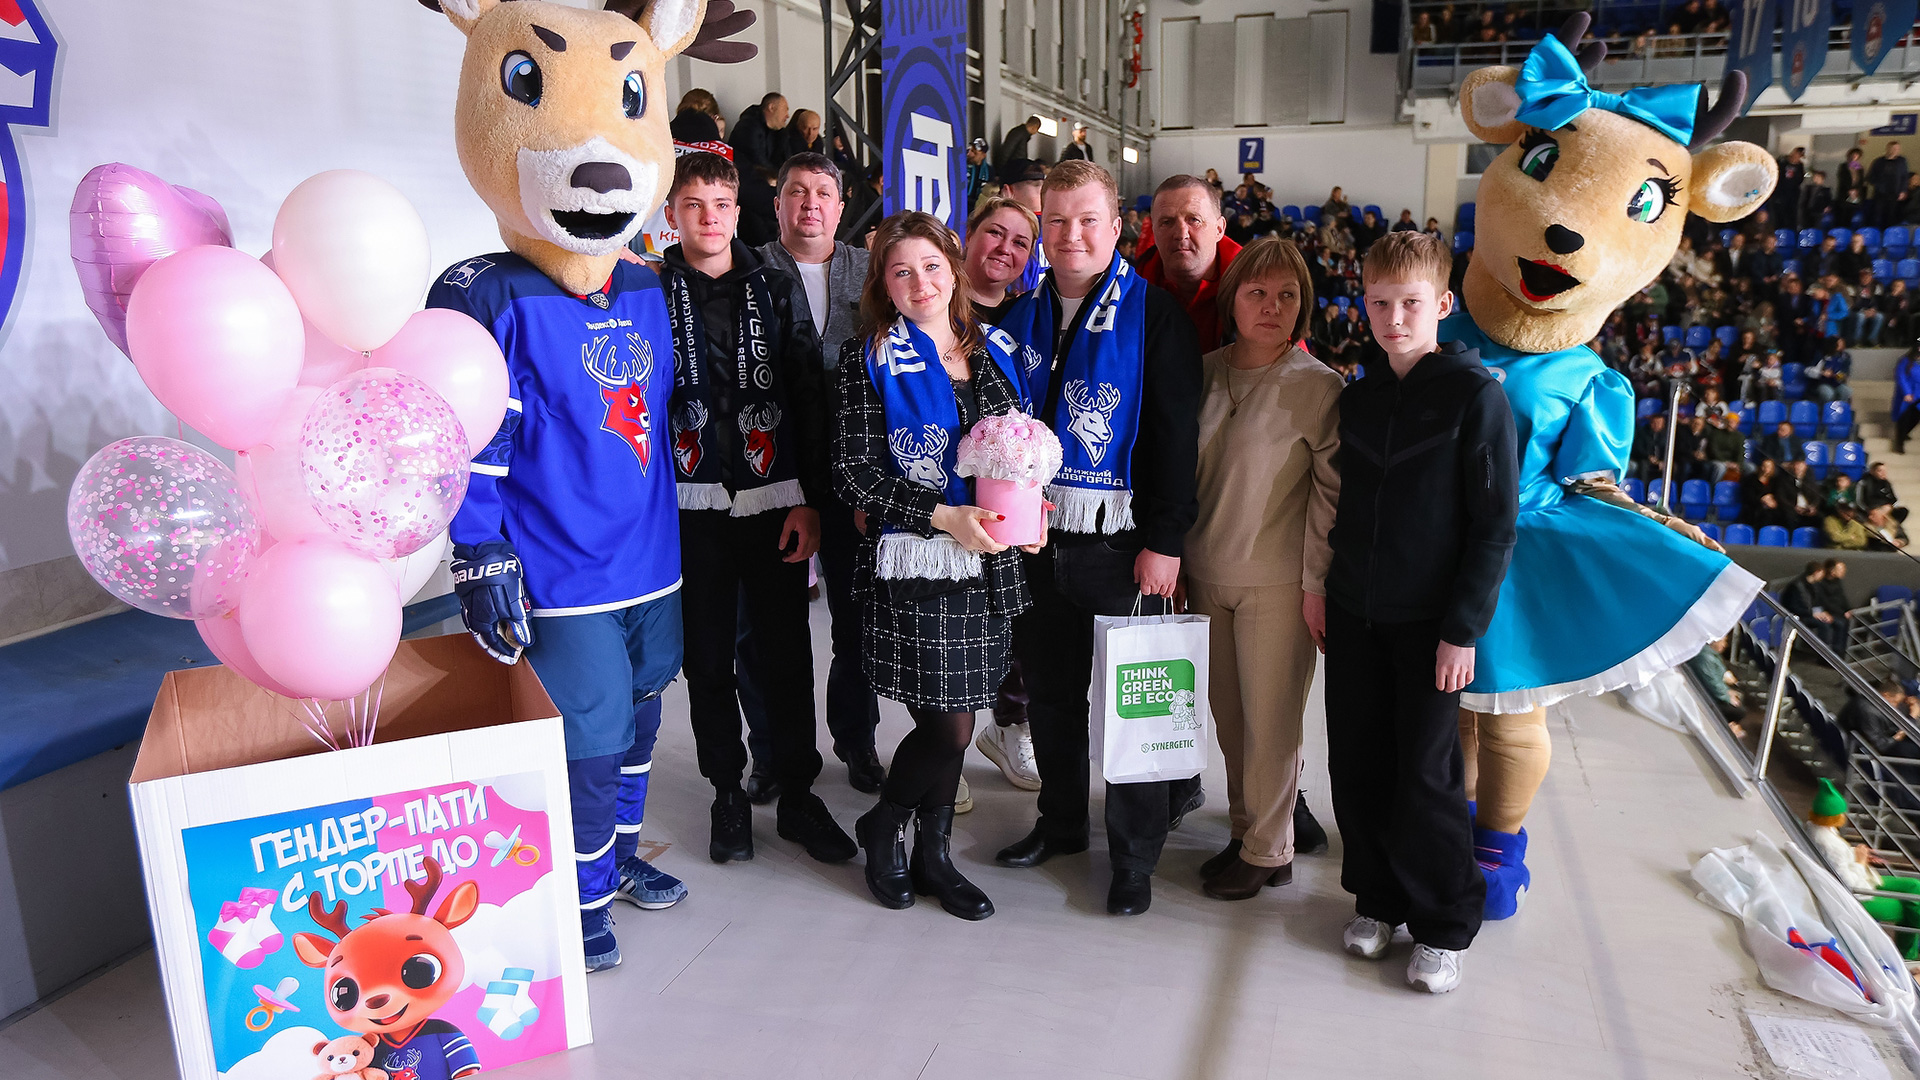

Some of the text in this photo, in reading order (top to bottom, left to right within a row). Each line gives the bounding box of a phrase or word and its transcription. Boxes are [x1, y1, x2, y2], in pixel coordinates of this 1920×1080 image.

[1245, 141, 1258, 160] 7
[681, 289, 699, 385] НИЖЕГОРОДСКАЯ
[738, 347, 748, 389] REGION
[1121, 666, 1169, 681] THINK
[1121, 679, 1173, 694] GREEN
[1121, 690, 1177, 706] BE ECO
[1151, 739, 1194, 752] SYNERGETIC
[250, 784, 488, 874] ГЕНДЕР-ПАТИ
[281, 834, 480, 913] С ТОРПЕДО
